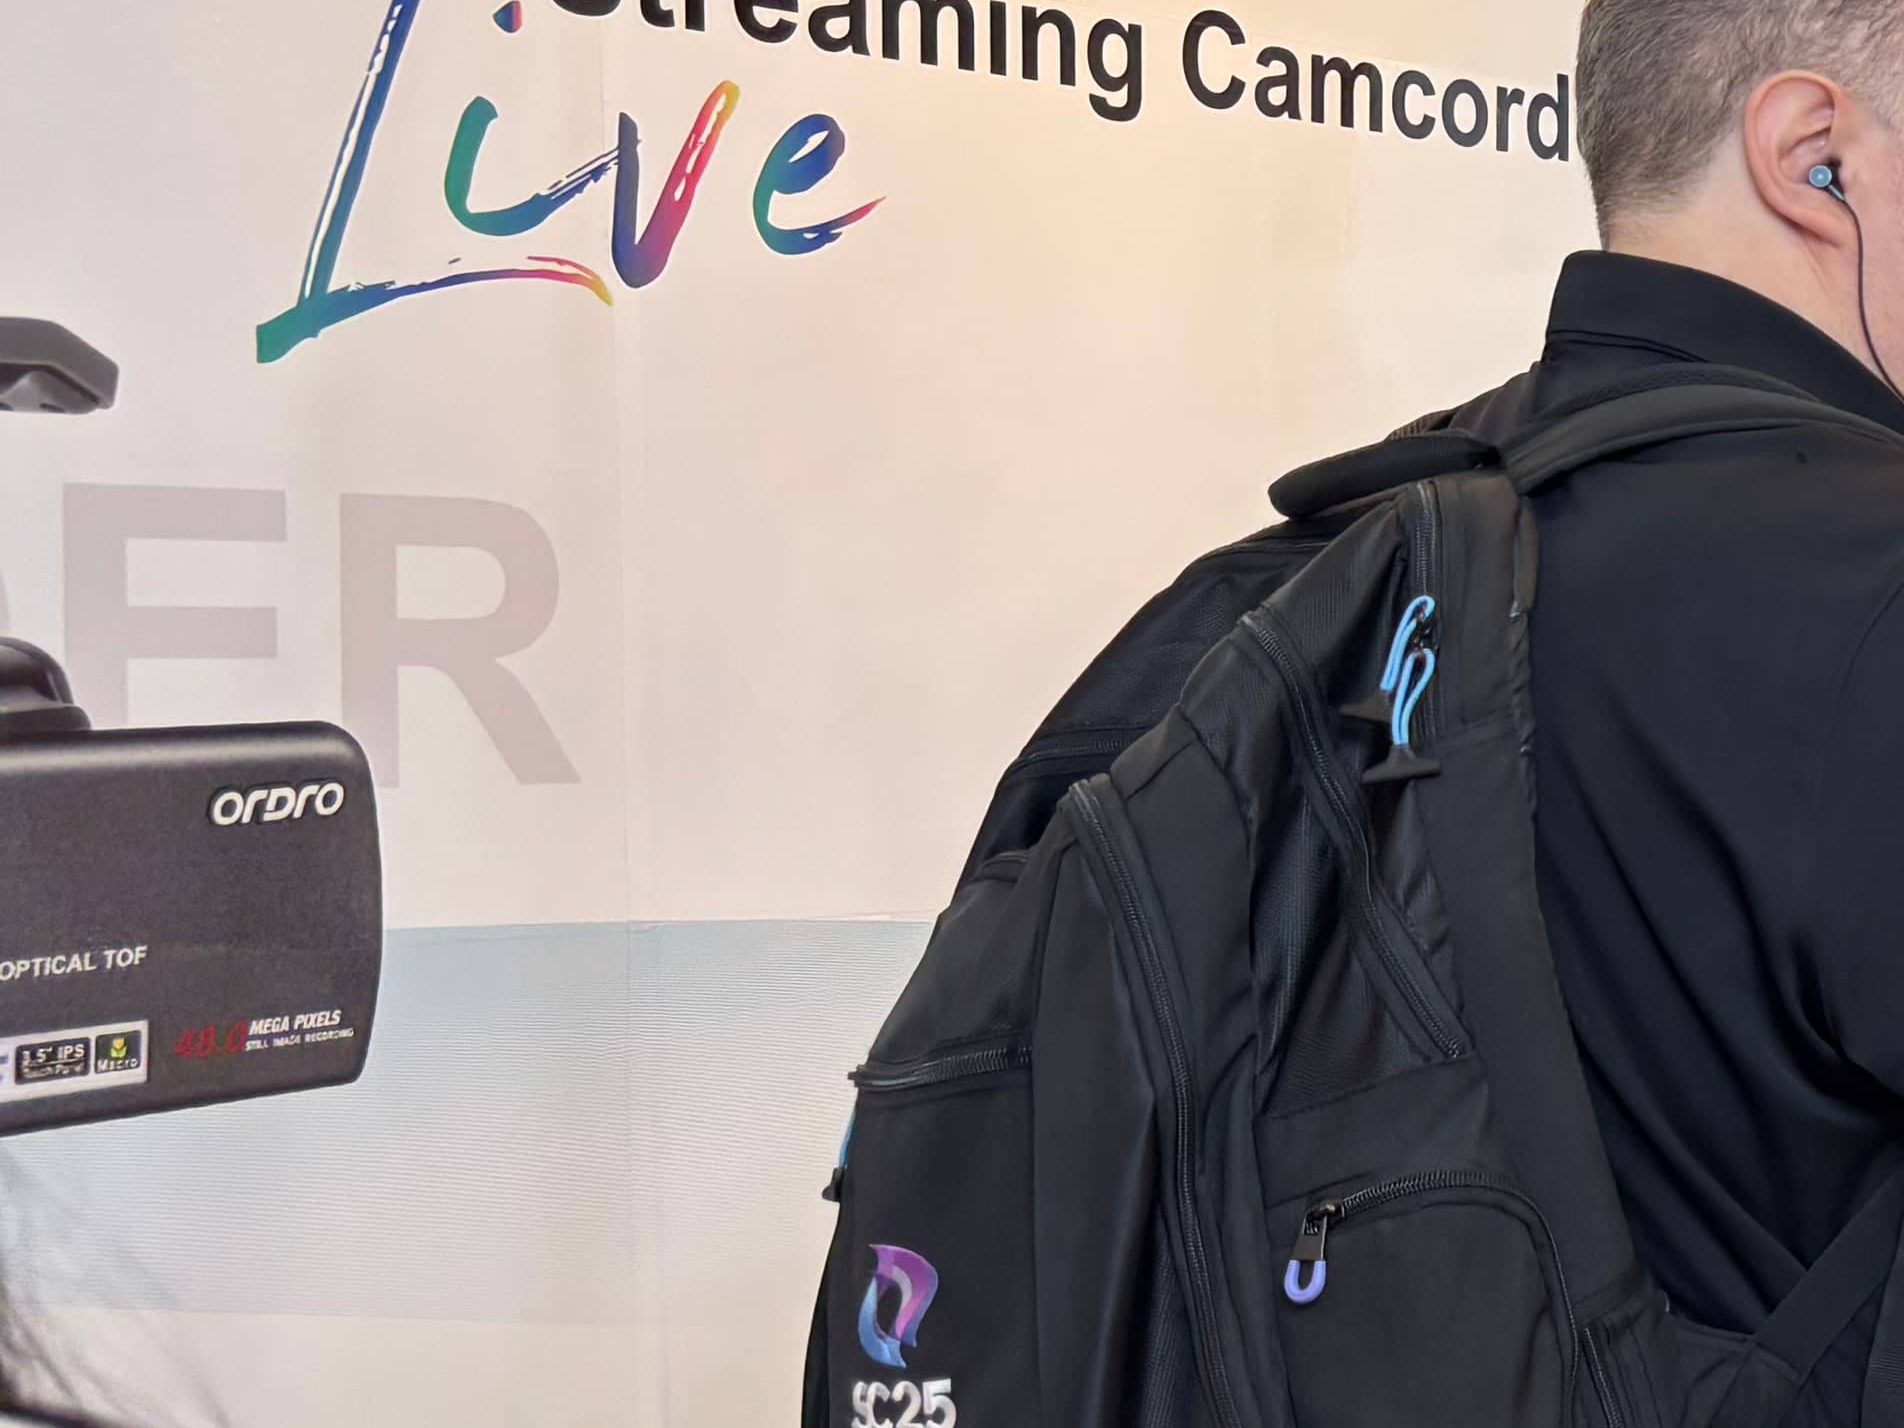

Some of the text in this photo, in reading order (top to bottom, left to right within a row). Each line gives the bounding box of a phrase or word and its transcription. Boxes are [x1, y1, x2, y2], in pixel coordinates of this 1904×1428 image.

[0, 945, 148, 982] OPTICAL TOF
[249, 1009, 342, 1037] MEGA PIXELS
[57, 1042, 86, 1060] IPS
